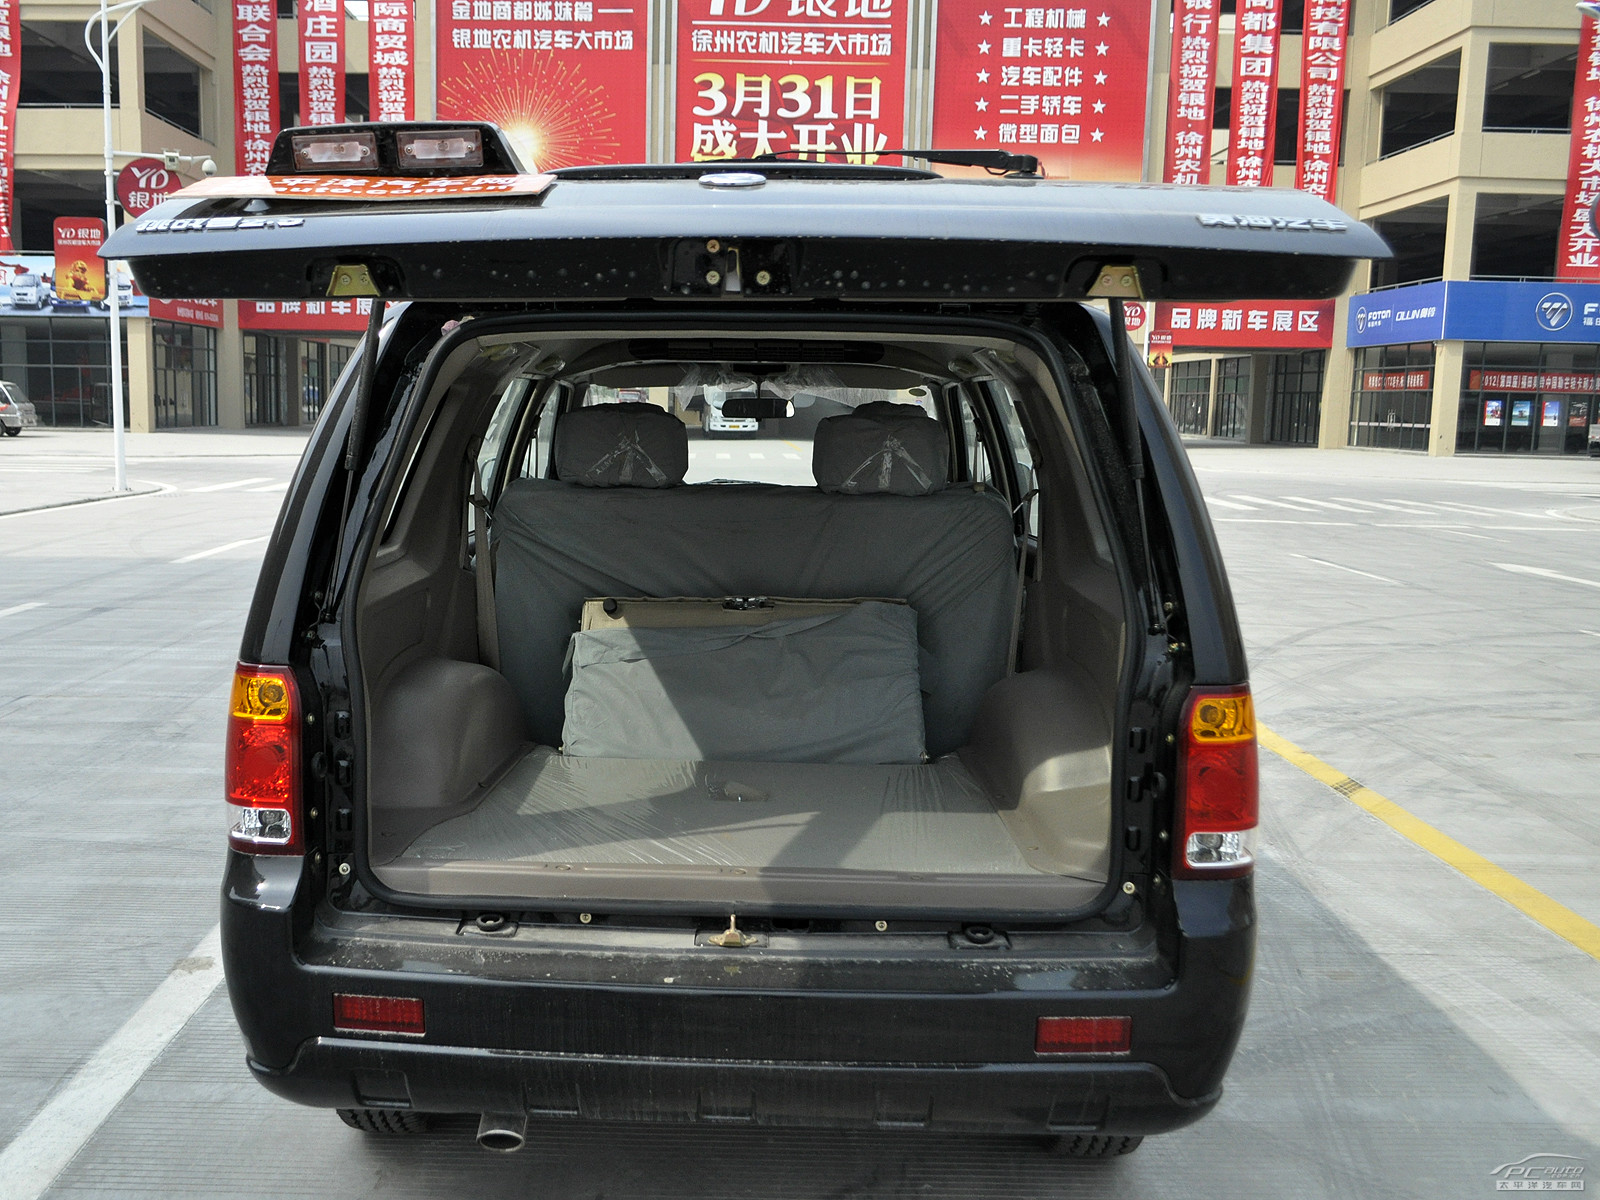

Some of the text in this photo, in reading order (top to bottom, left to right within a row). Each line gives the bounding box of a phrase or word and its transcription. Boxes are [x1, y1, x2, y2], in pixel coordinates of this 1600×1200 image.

[1003, 7, 1087, 29] 工程机械
[452, 28, 634, 50] 银地农机汽车大市场
[691, 29, 892, 56] 徐州农机汽车大市场
[1002, 36, 1085, 58] 重卡轻卡
[1001, 65, 1083, 87] 汽车配件
[692, 72, 882, 120] 3月31日
[1000, 94, 1082, 116] 二手轿车
[690, 119, 888, 165] 盛大开业
[998, 123, 1081, 144] 微型面包
[1171, 307, 1320, 332] 品牌新车展区
[1368, 309, 1391, 321] FOTON
